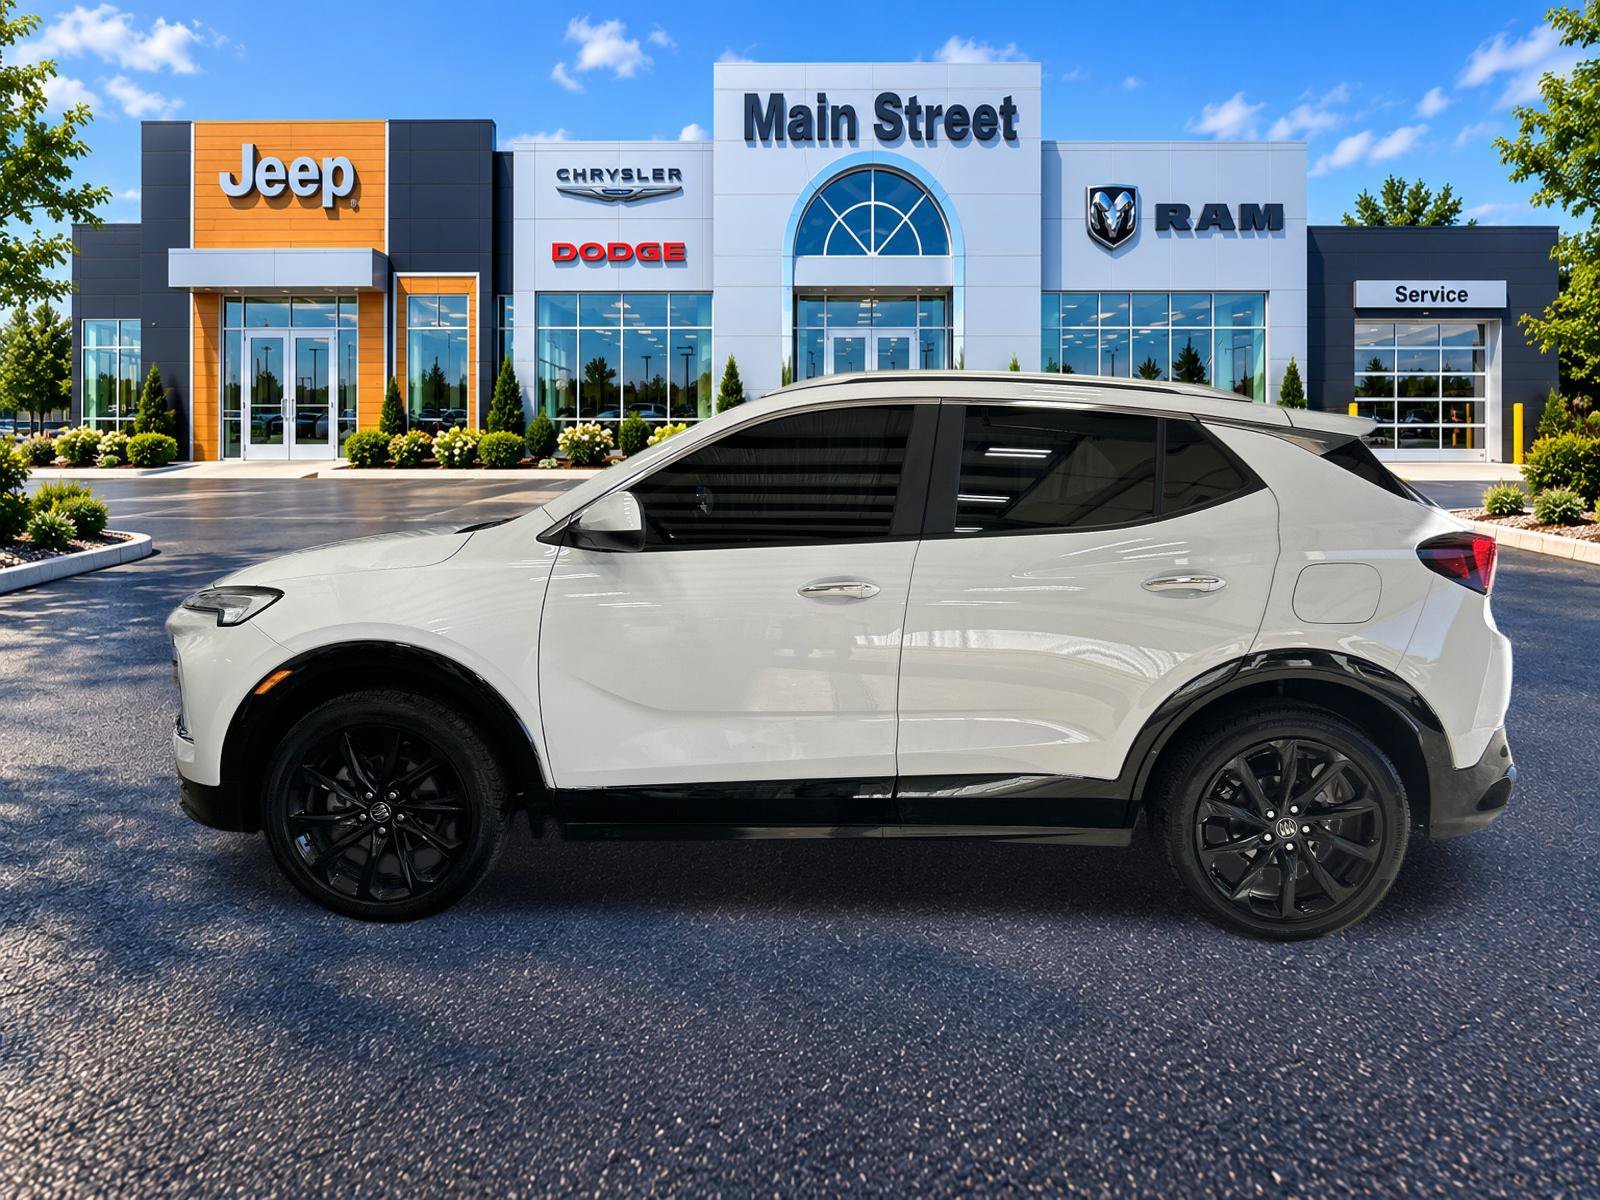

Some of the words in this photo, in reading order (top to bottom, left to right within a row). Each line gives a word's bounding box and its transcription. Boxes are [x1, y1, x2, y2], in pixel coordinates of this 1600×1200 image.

[743, 92, 858, 141] Main
[873, 91, 1018, 142] Street
[218, 143, 355, 209] Jeep
[556, 168, 683, 182] CHRYSLER
[1155, 203, 1284, 231] RAM
[551, 242, 686, 262] DODGE
[1395, 285, 1469, 303] Service
